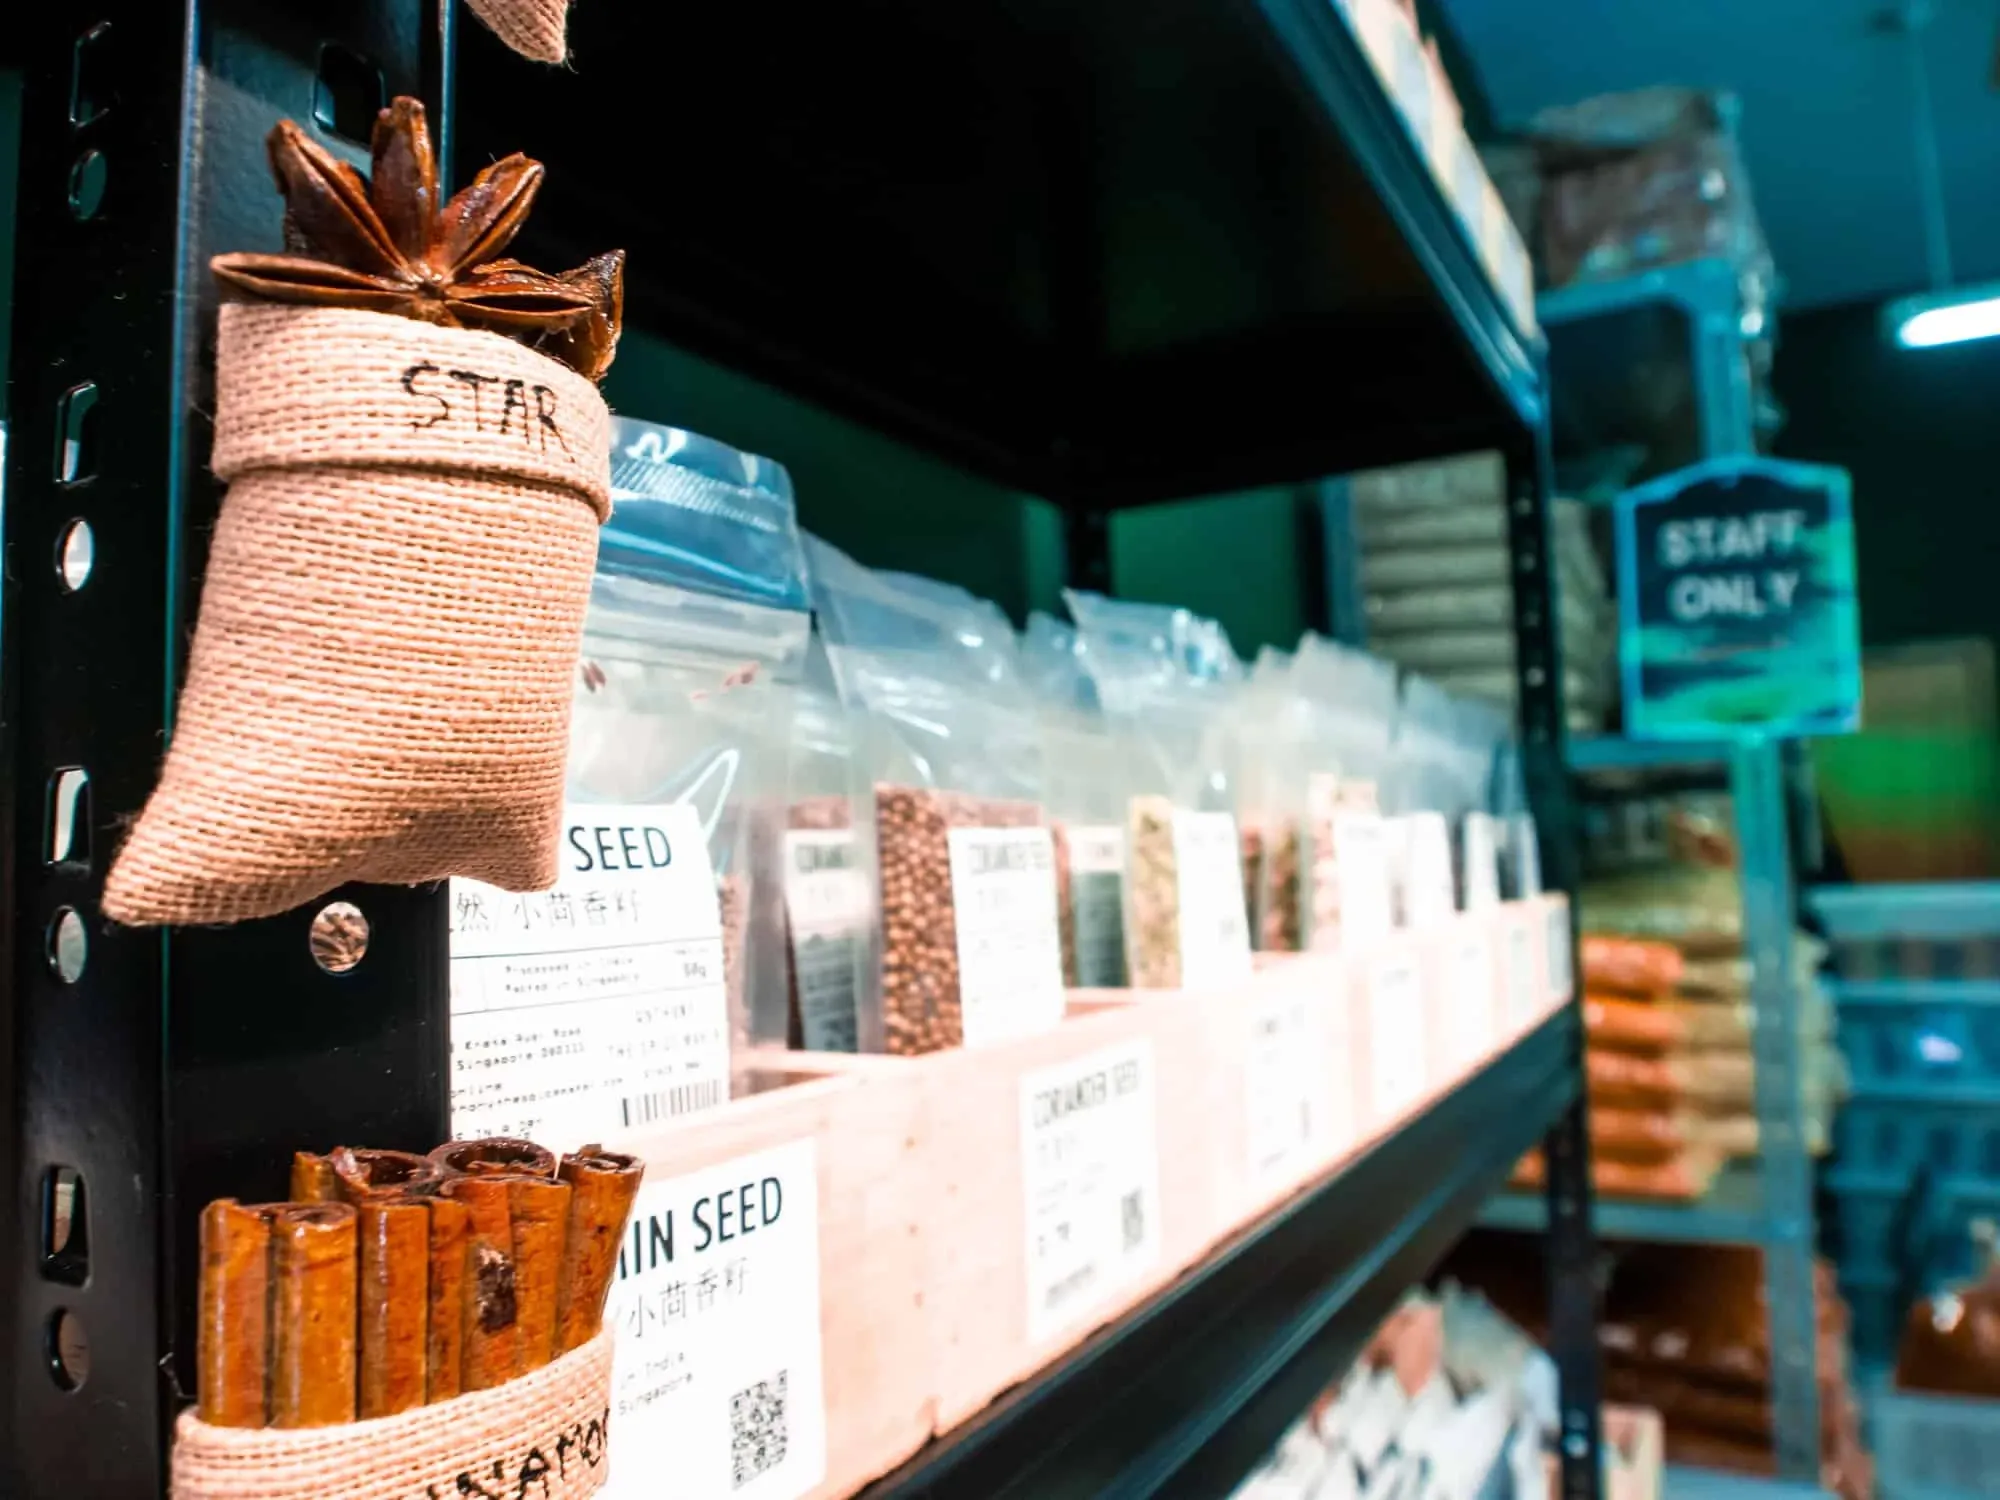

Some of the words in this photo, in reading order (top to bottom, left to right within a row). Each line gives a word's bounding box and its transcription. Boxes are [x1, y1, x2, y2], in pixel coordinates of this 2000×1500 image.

[401, 360, 575, 463] STAR
[1659, 509, 1806, 567] STAFF
[1668, 570, 1799, 621] ONLY
[568, 826, 672, 872] SEED
[620, 1210, 675, 1280] IN
[692, 1176, 783, 1252] SEED
